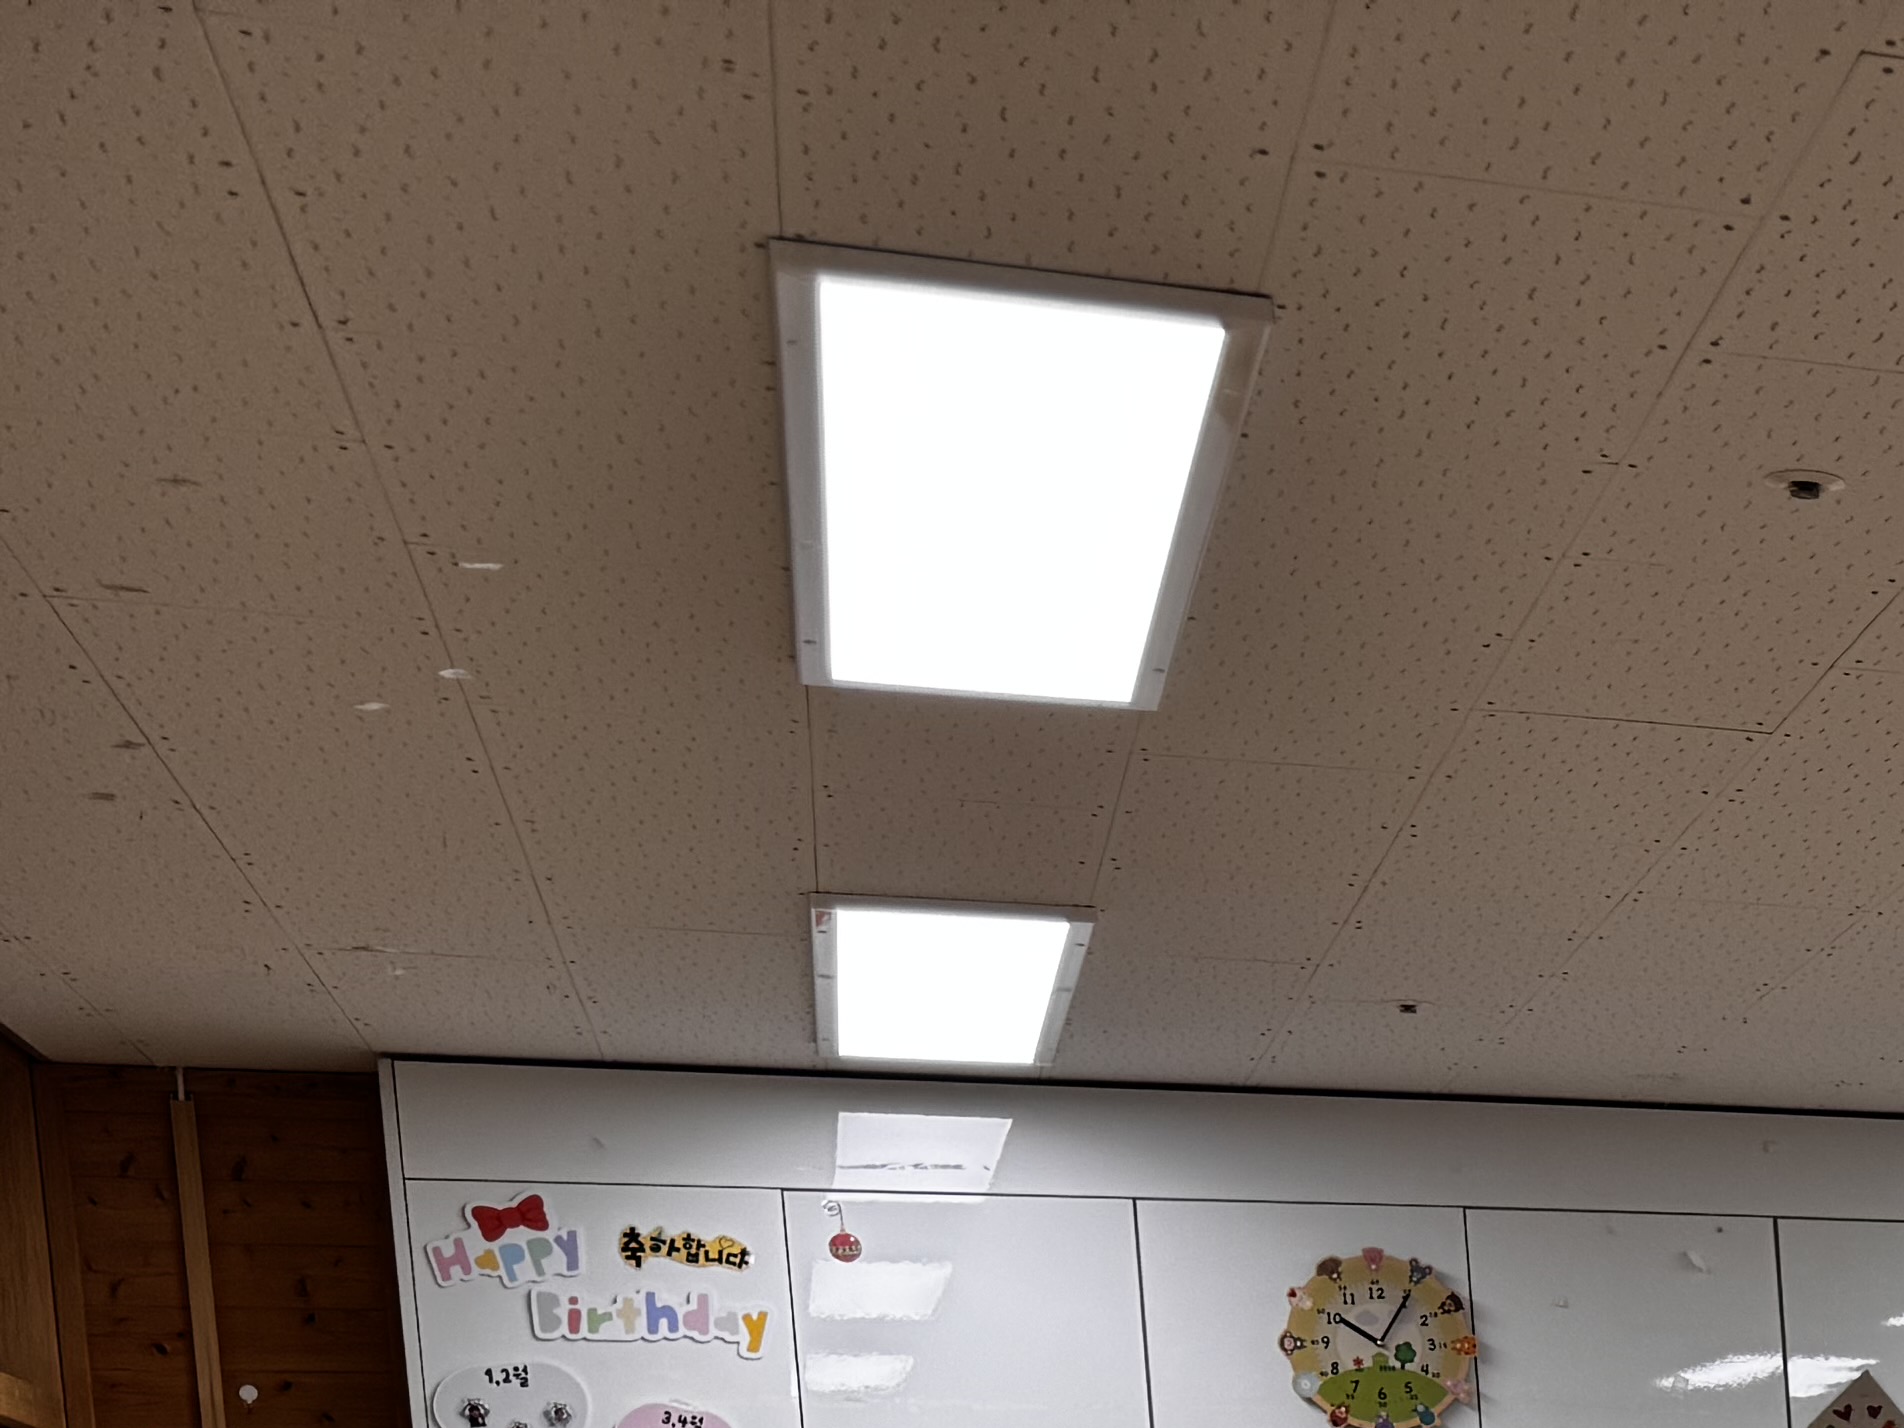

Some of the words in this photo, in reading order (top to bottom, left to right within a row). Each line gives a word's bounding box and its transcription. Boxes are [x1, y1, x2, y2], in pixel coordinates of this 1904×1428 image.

[620, 1226, 750, 1269] 축하합니다
[1342, 1292, 1356, 1305] 11
[1368, 1287, 1385, 1299] 12
[535, 1291, 769, 1354] Birthday
[1326, 1312, 1343, 1325] 10
[1420, 1314, 1429, 1327] 2
[1321, 1335, 1330, 1349] 9
[1427, 1338, 1437, 1351] 3
[1330, 1361, 1340, 1376] 8
[1420, 1363, 1430, 1376] 4
[1350, 1380, 1360, 1393] 7
[1404, 1381, 1414, 1394] 5
[1378, 1387, 1388, 1401] 6
